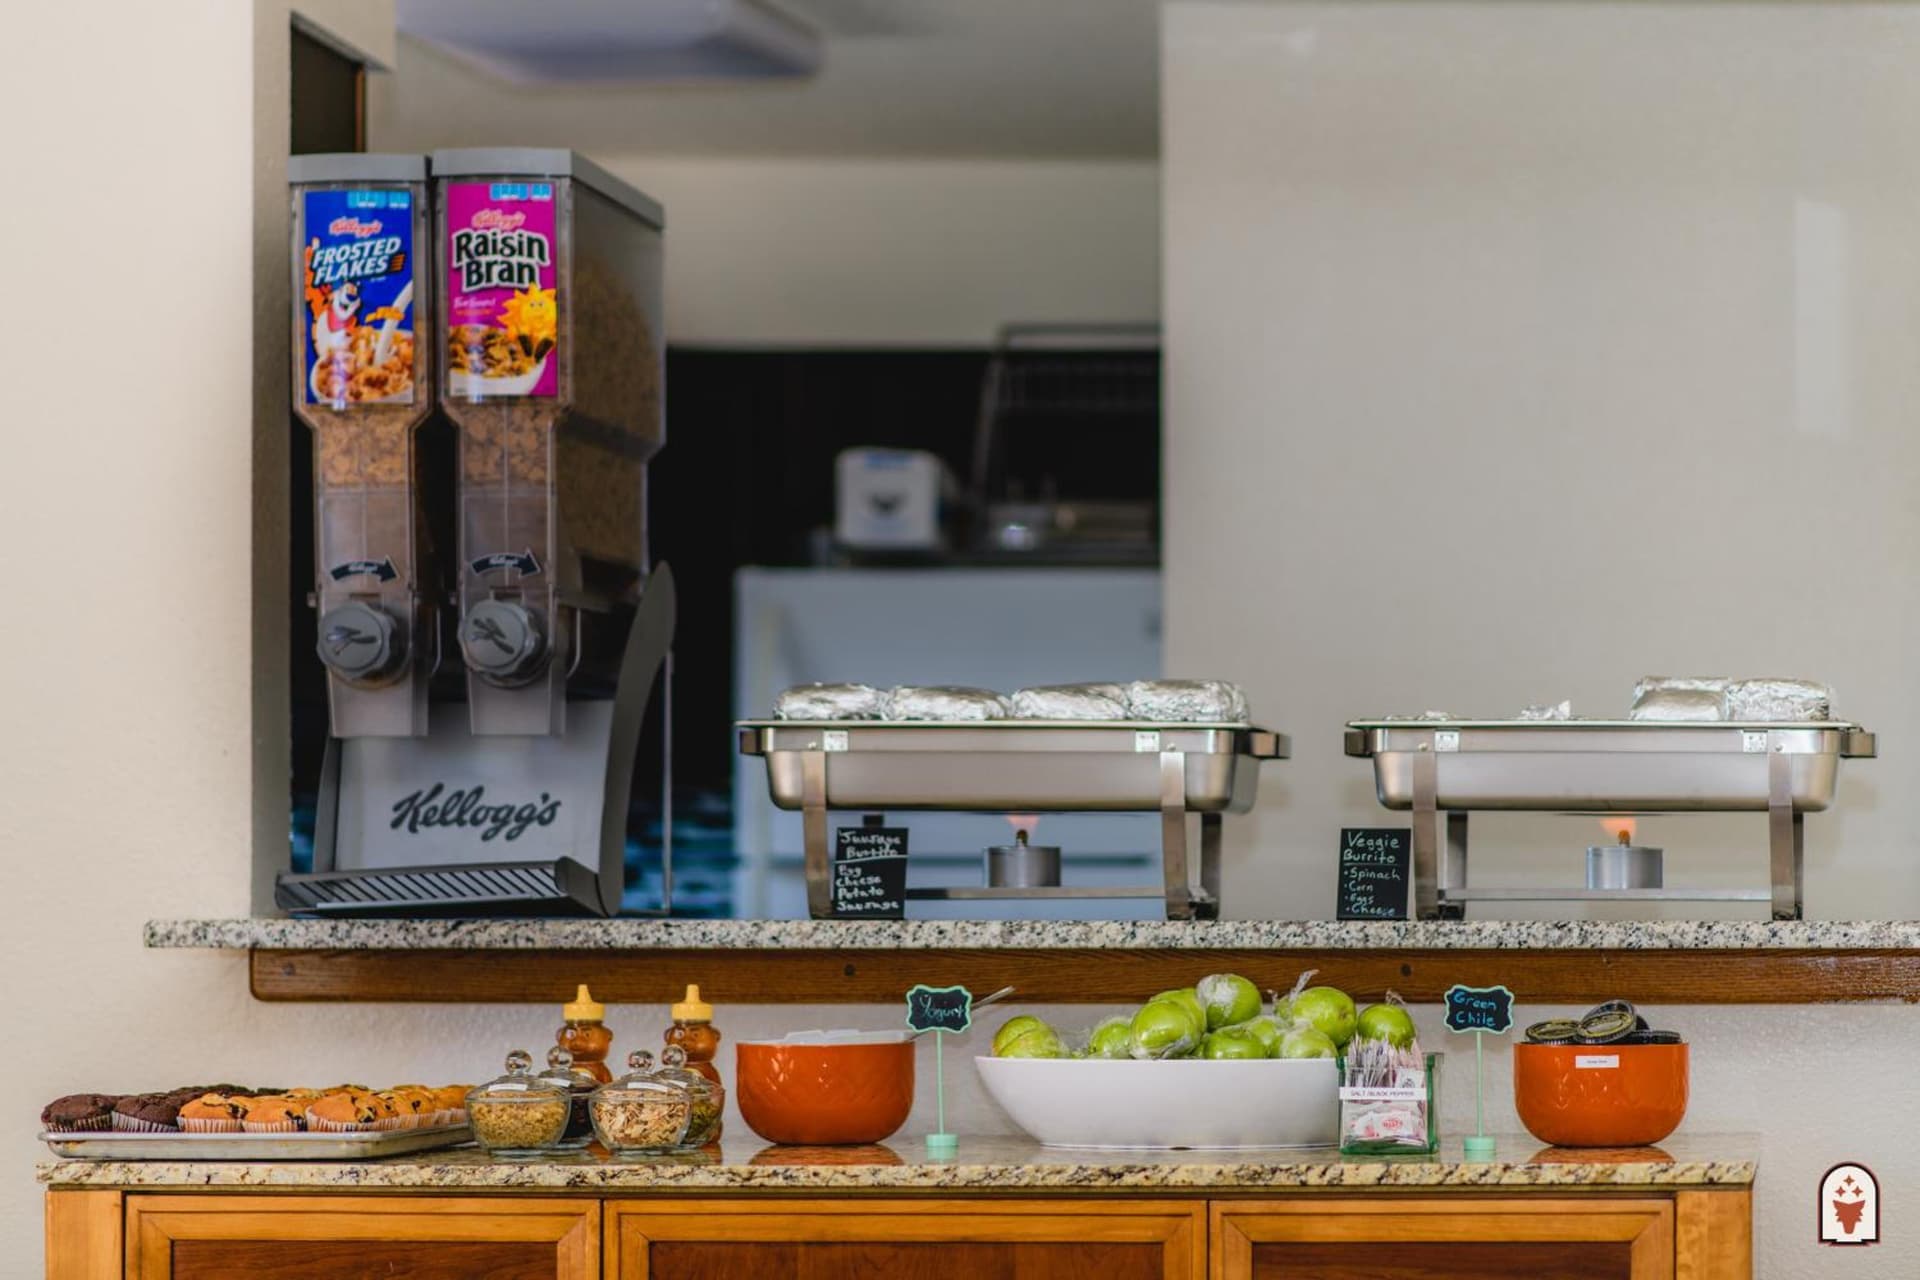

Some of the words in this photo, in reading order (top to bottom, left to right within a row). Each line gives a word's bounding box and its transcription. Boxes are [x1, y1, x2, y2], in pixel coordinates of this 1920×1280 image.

[312, 237, 402, 269] FROSTED
[454, 231, 548, 264] Raisin
[314, 256, 388, 285] FLAKES
[464, 258, 537, 289] Bran
[390, 782, 562, 842] Kellogg's
[1347, 831, 1400, 851] Veggie
[1343, 848, 1396, 864] Burrito
[1349, 866, 1401, 881] Spinach
[1348, 880, 1374, 892] Corn
[919, 994, 964, 1022] Yogurt
[1453, 991, 1497, 1011] Green
[1455, 1010, 1496, 1027] Chile
